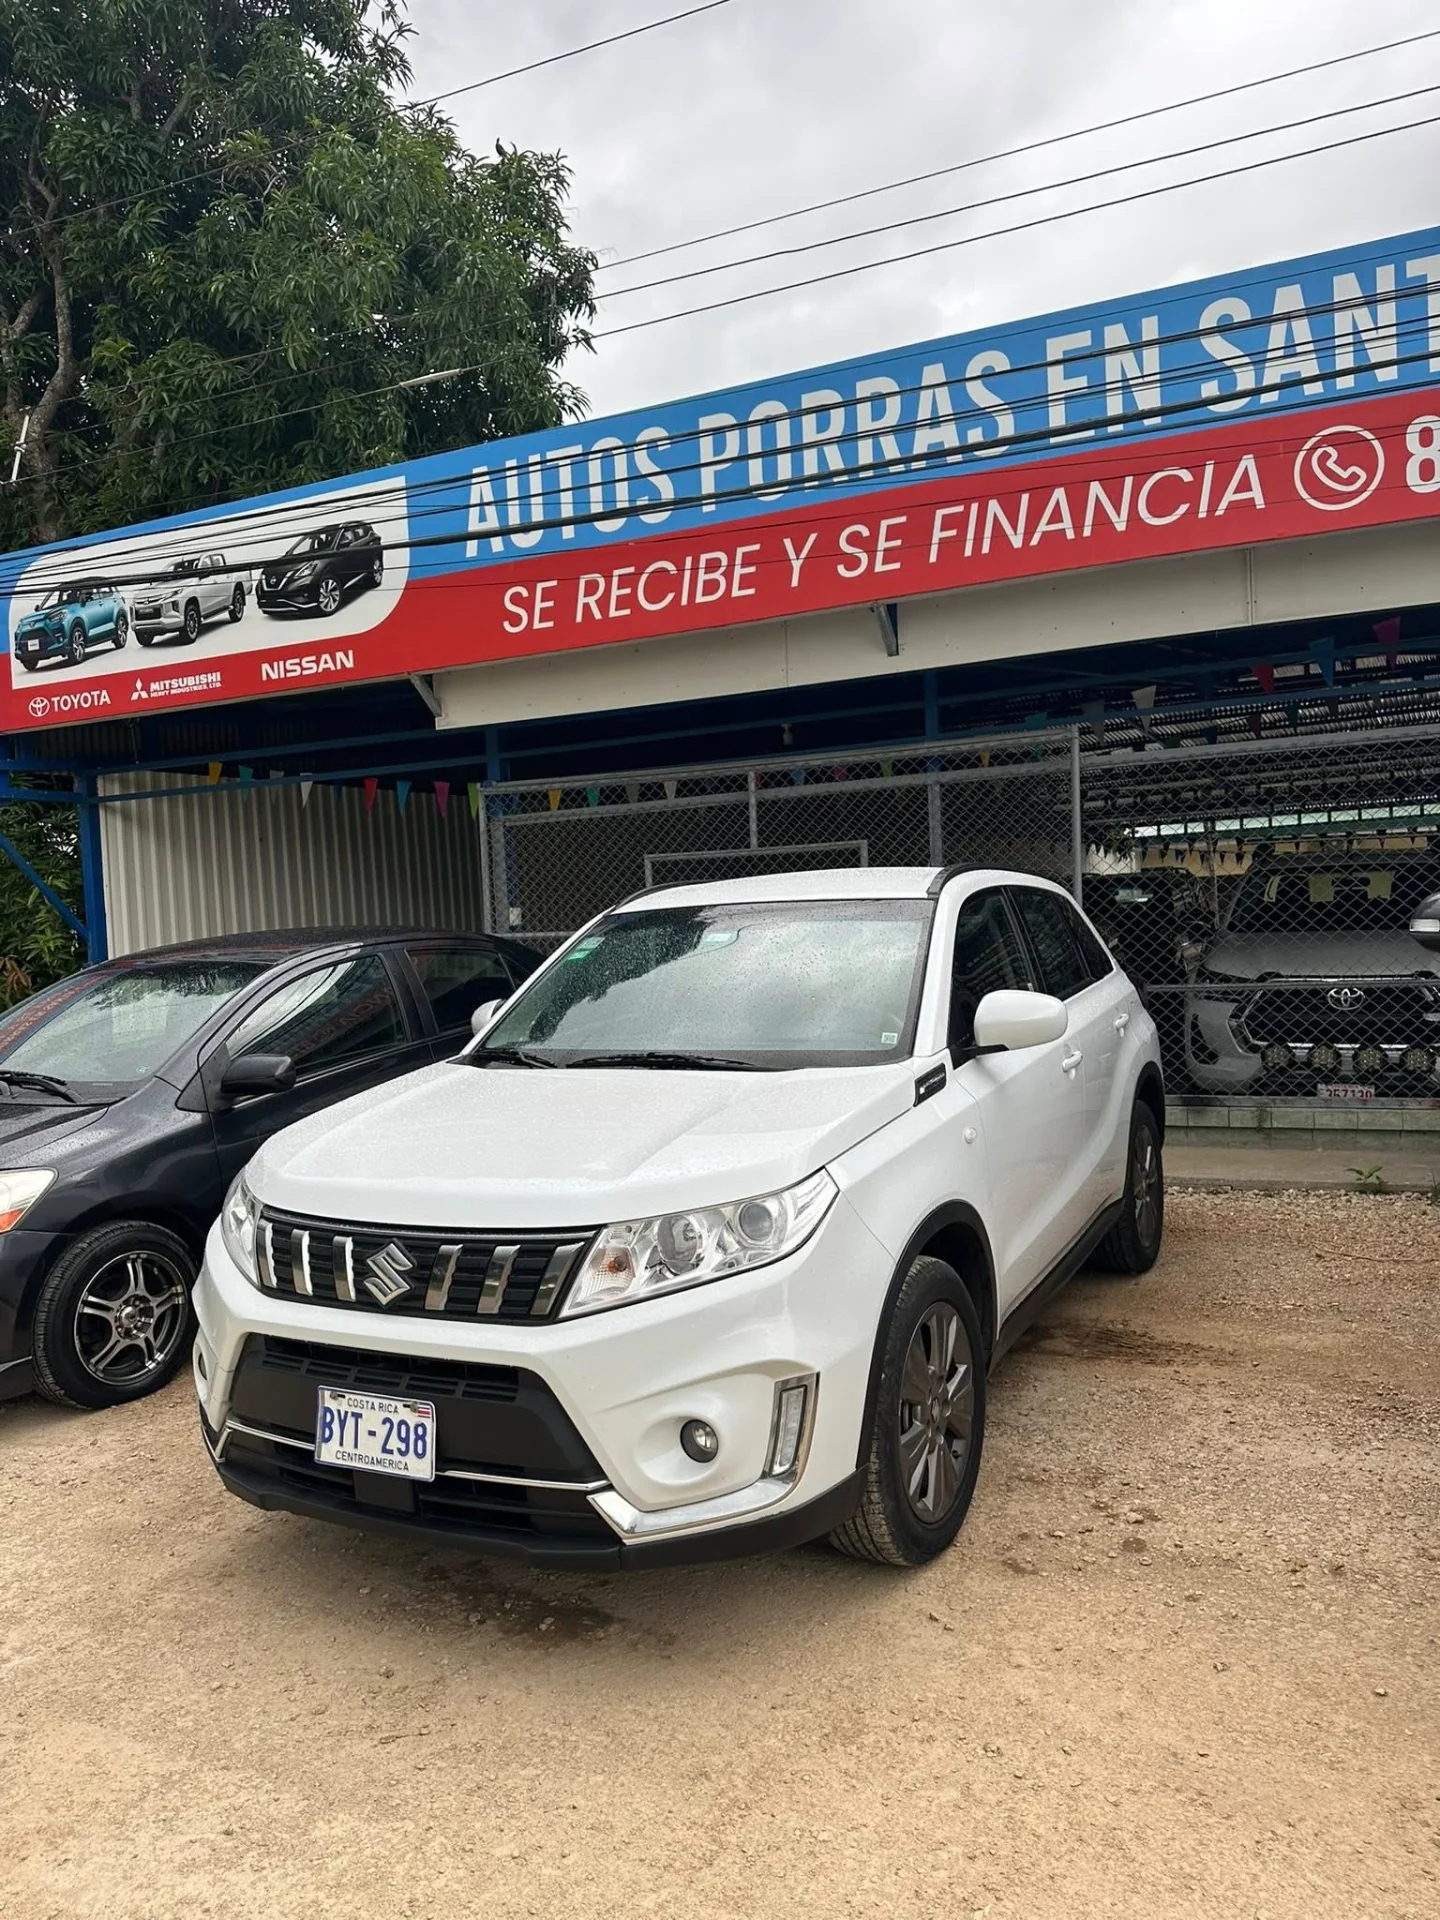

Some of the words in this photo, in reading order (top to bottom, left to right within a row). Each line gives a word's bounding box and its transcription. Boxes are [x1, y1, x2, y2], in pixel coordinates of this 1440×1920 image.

[466, 427, 675, 558] AUTOS
[699, 350, 1015, 513] PORRAS
[1046, 315, 1163, 442] EN
[1199, 255, 1440, 413] SANT
[1406, 415, 1440, 494] 8
[502, 580, 556, 634] SE
[574, 544, 761, 623] RECIBE
[783, 533, 818, 587] Y
[837, 516, 907, 579] SE
[930, 455, 1266, 563] FINANCIA
[261, 650, 354, 681] NISSAN
[150, 671, 221, 692] MITSUBISHI
[150, 690, 169, 698] HEAVY
[51, 689, 111, 712] TOYOTA
[347, 1397, 376, 1411] COSTA
[378, 1402, 399, 1414] RICA
[321, 1405, 427, 1460] BYT-298
[335, 1450, 409, 1471] CENTROAMERICA
